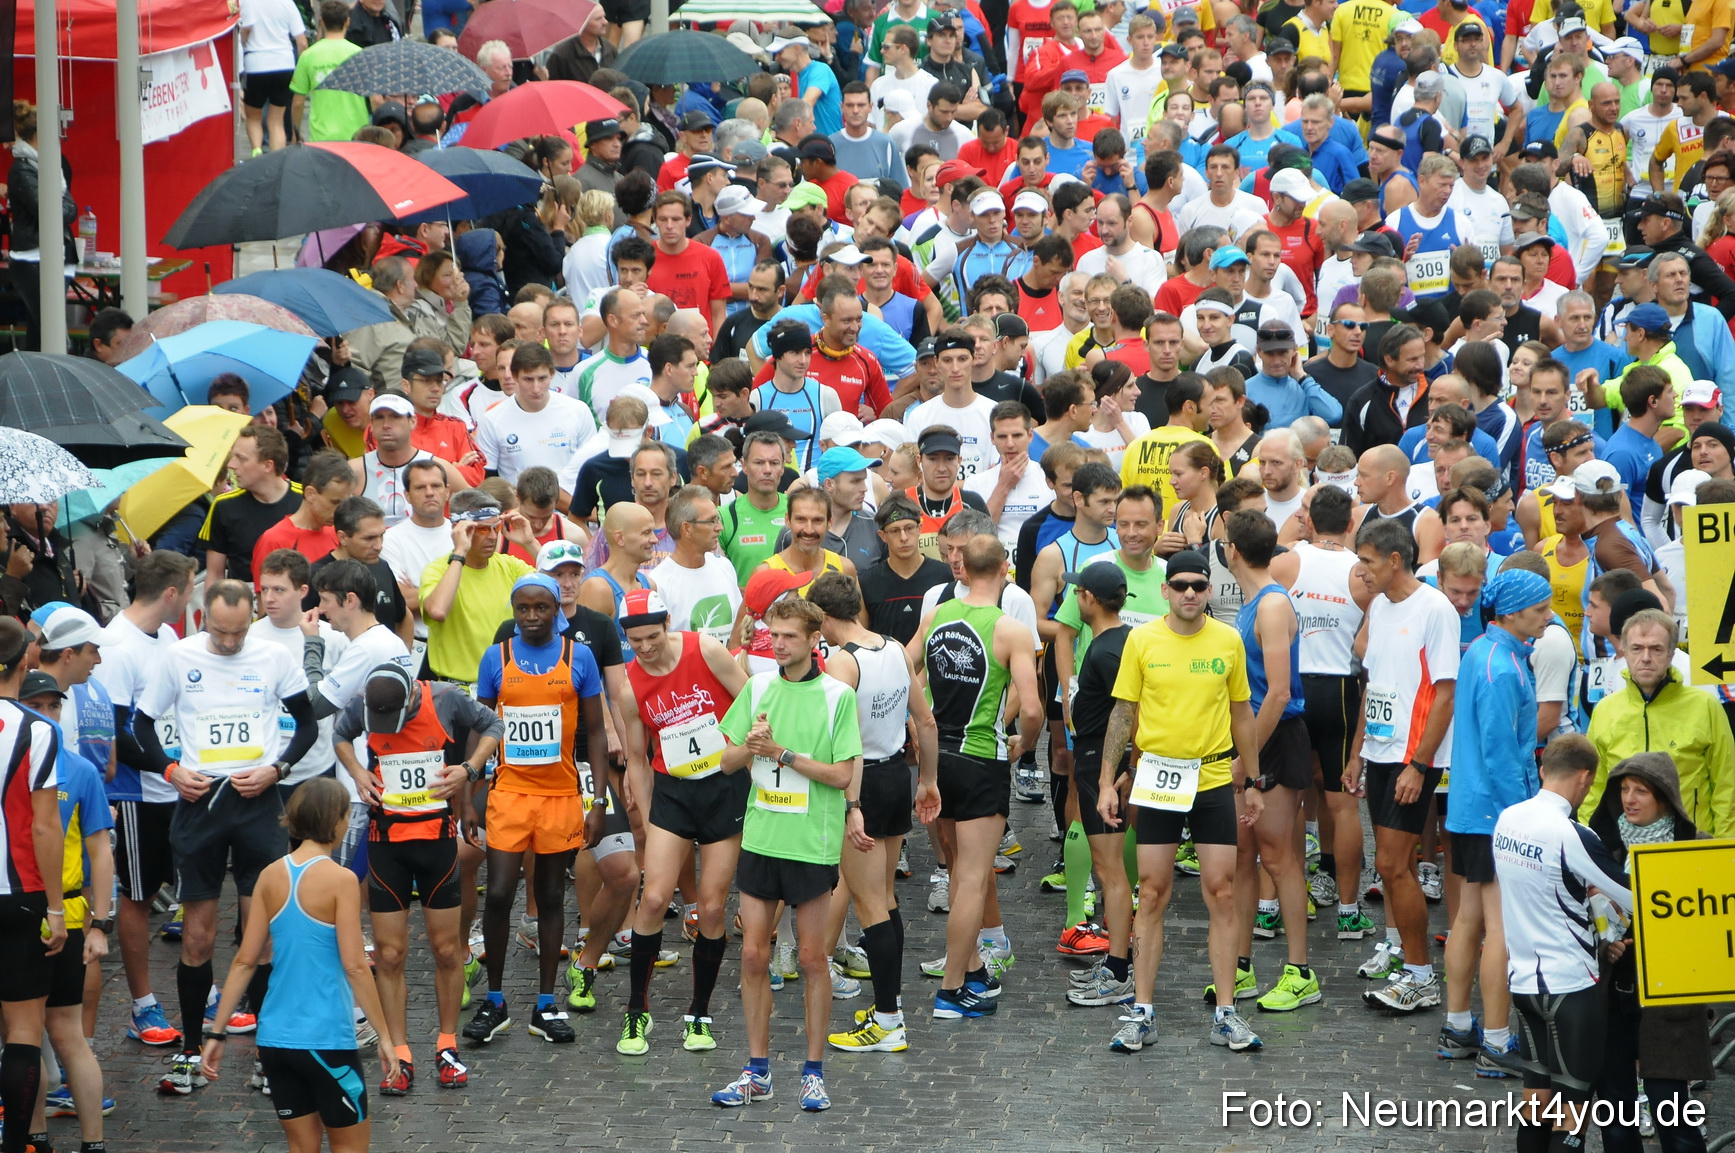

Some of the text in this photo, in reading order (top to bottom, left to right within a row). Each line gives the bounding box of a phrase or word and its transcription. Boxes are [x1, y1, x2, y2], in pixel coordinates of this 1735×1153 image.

[1354, 5, 1383, 22] MTP
[1415, 261, 1443, 279] 309
[841, 374, 863, 385] Markus
[1137, 465, 1172, 476] Hersbruc
[1306, 592, 1348, 605] KLEBL
[929, 631, 983, 655] DAV Röthenbach
[1192, 661, 1210, 669] BIKE
[944, 672, 980, 684] LAUF-TEAM
[870, 686, 907, 719] Regensburg
[871, 689, 900, 711] Marathon
[872, 692, 886, 703] LLC
[1365, 698, 1393, 722] 2676
[196, 714, 217, 722] PARTL
[210, 722, 250, 745] 578
[508, 719, 554, 742] 2001
[661, 723, 707, 742] PARTL Neumarkt
[516, 747, 548, 757] Zachary
[688, 736, 701, 756] 4
[404, 758, 433, 766] Neumarkt
[691, 760, 709, 772] Uwe
[1161, 762, 1190, 770] Neumarkt
[400, 767, 426, 790] 98
[771, 766, 780, 788] 1
[1155, 769, 1182, 790] 99
[401, 793, 427, 805] Hynek
[764, 791, 791, 804] Michael
[1150, 792, 1175, 803] Stefan
[1506, 828, 1530, 841] TEAM
[1495, 832, 1543, 863] ERDINGER
